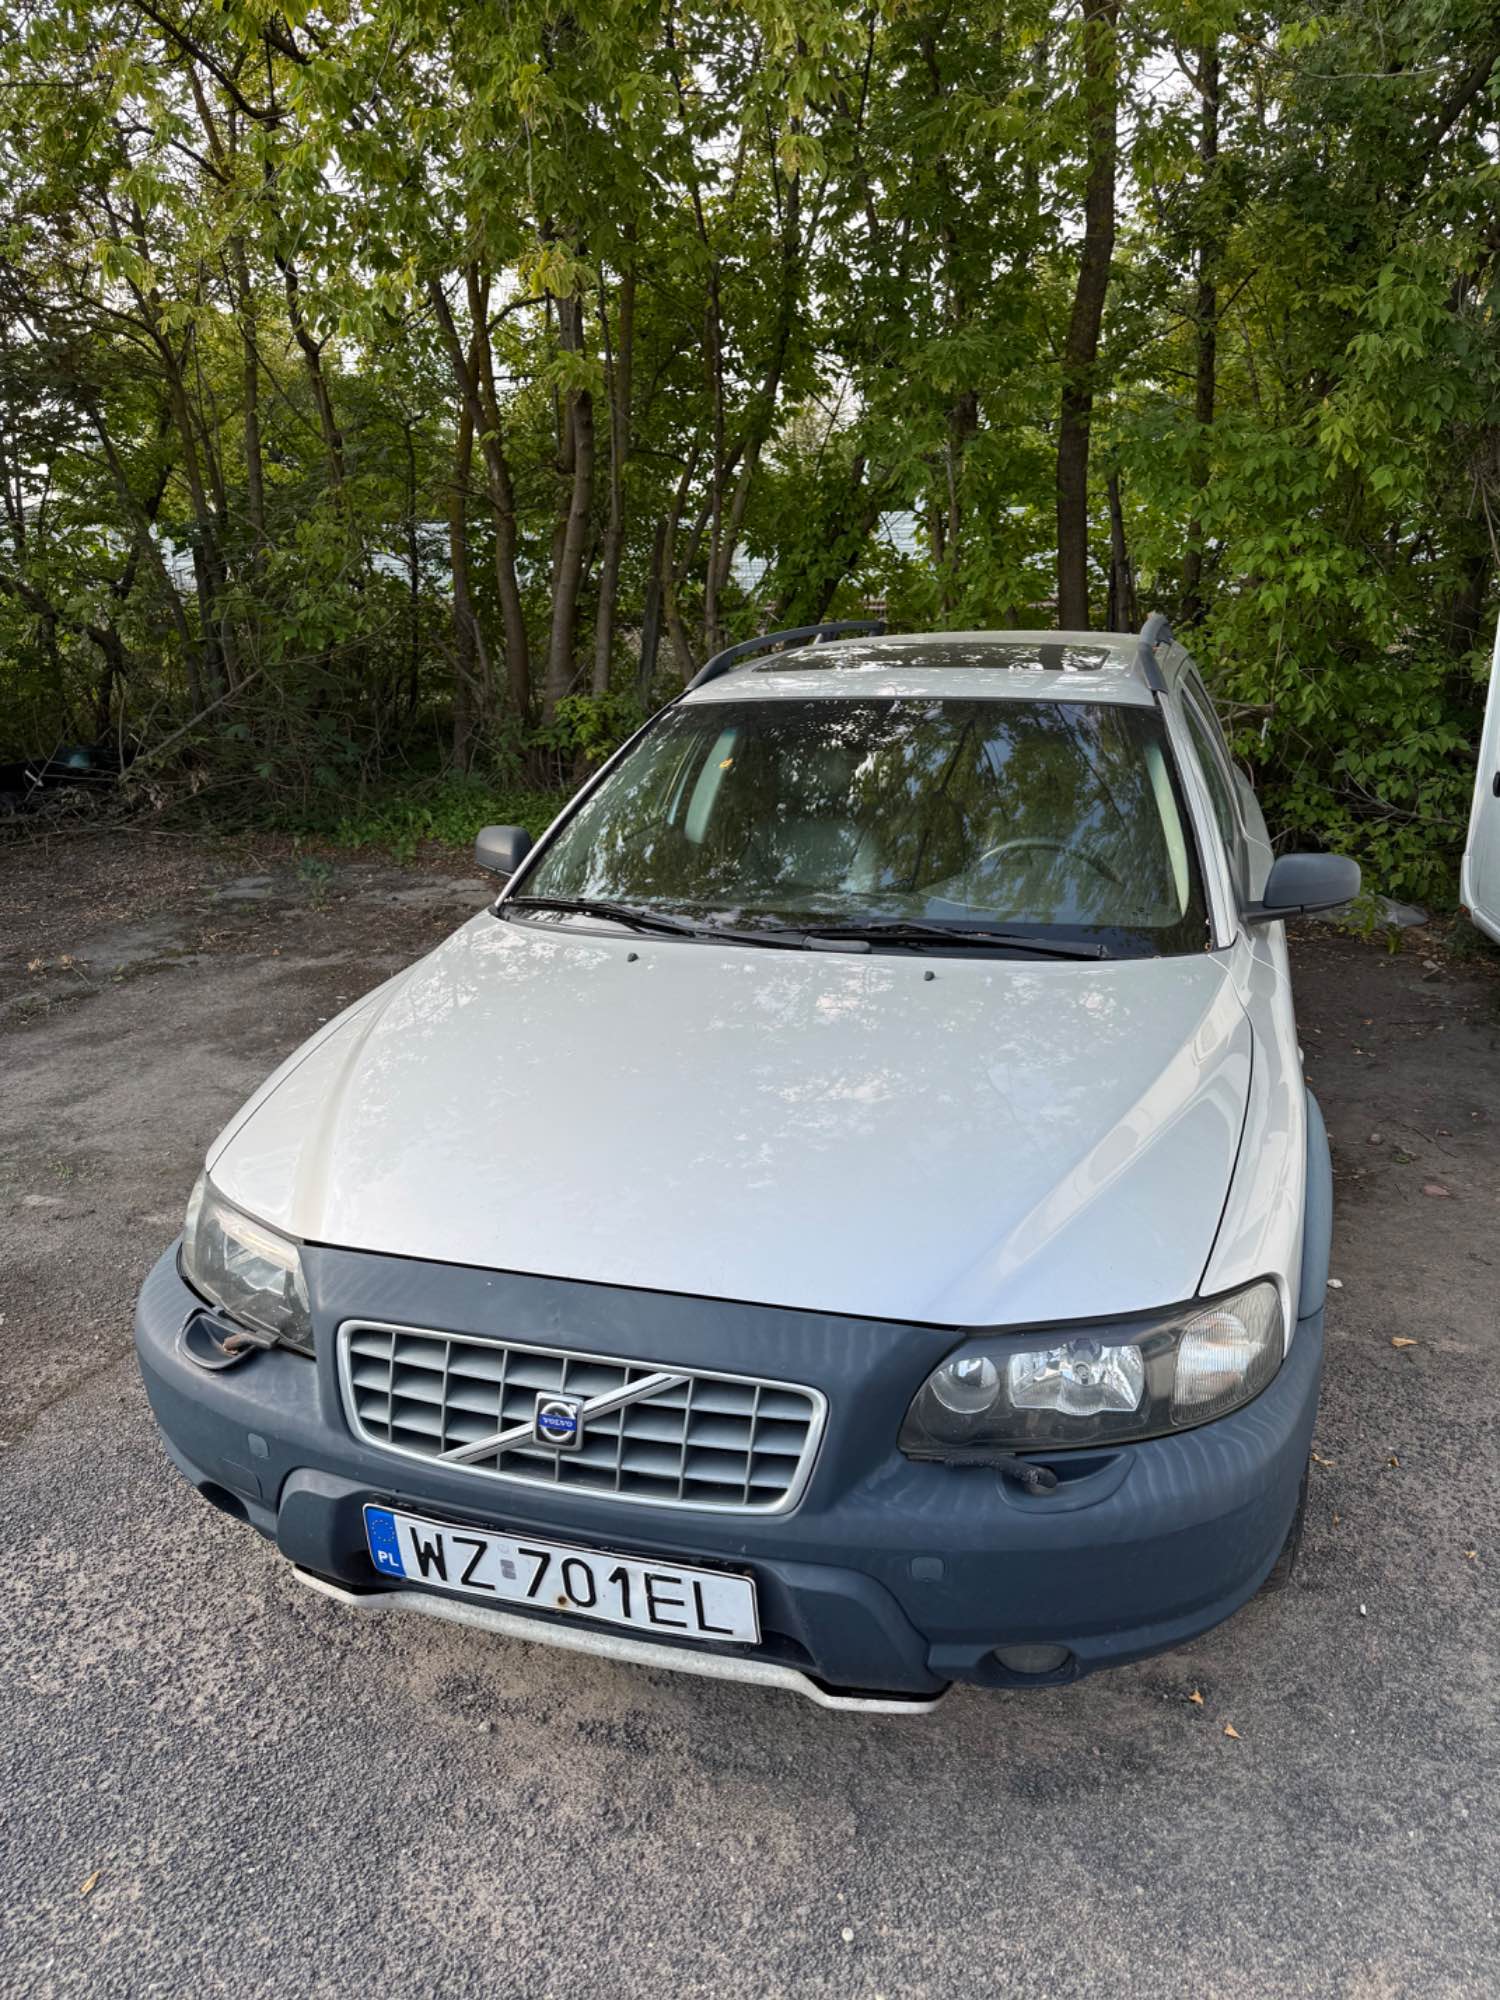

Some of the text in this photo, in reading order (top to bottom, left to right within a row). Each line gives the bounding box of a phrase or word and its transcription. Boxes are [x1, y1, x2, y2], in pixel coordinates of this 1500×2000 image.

[543, 1417, 573, 1427] VOLVO
[377, 1550, 399, 1567] PL
[409, 1526, 734, 1635] WZ 701EL
